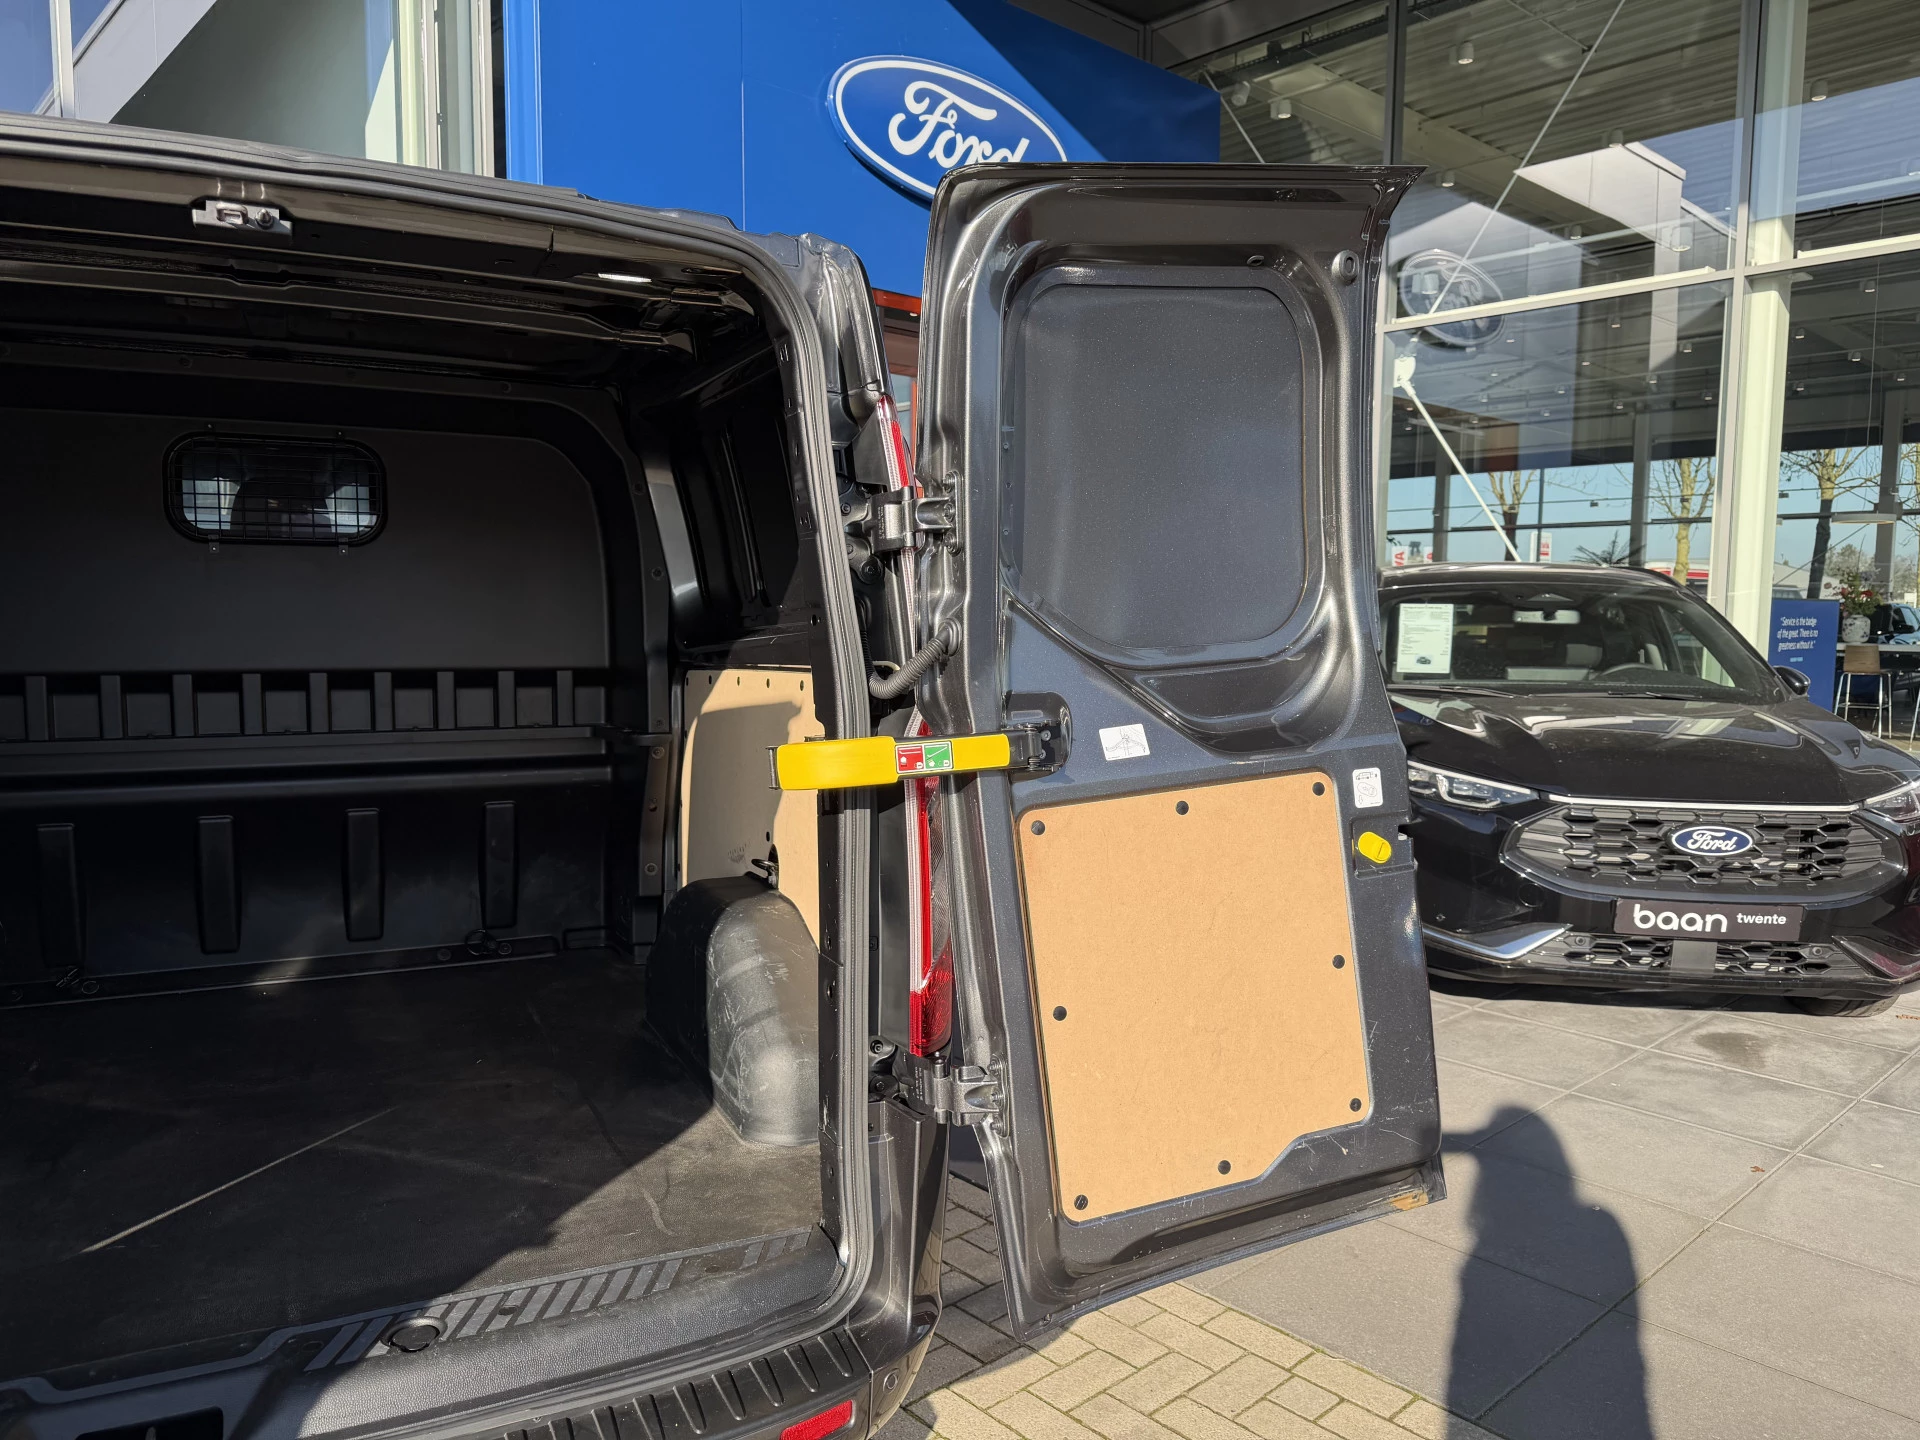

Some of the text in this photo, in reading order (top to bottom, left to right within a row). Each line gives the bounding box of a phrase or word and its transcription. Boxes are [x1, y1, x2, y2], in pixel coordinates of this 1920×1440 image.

[1686, 829, 1738, 851] Ford
[1632, 903, 1787, 933] baan twente
